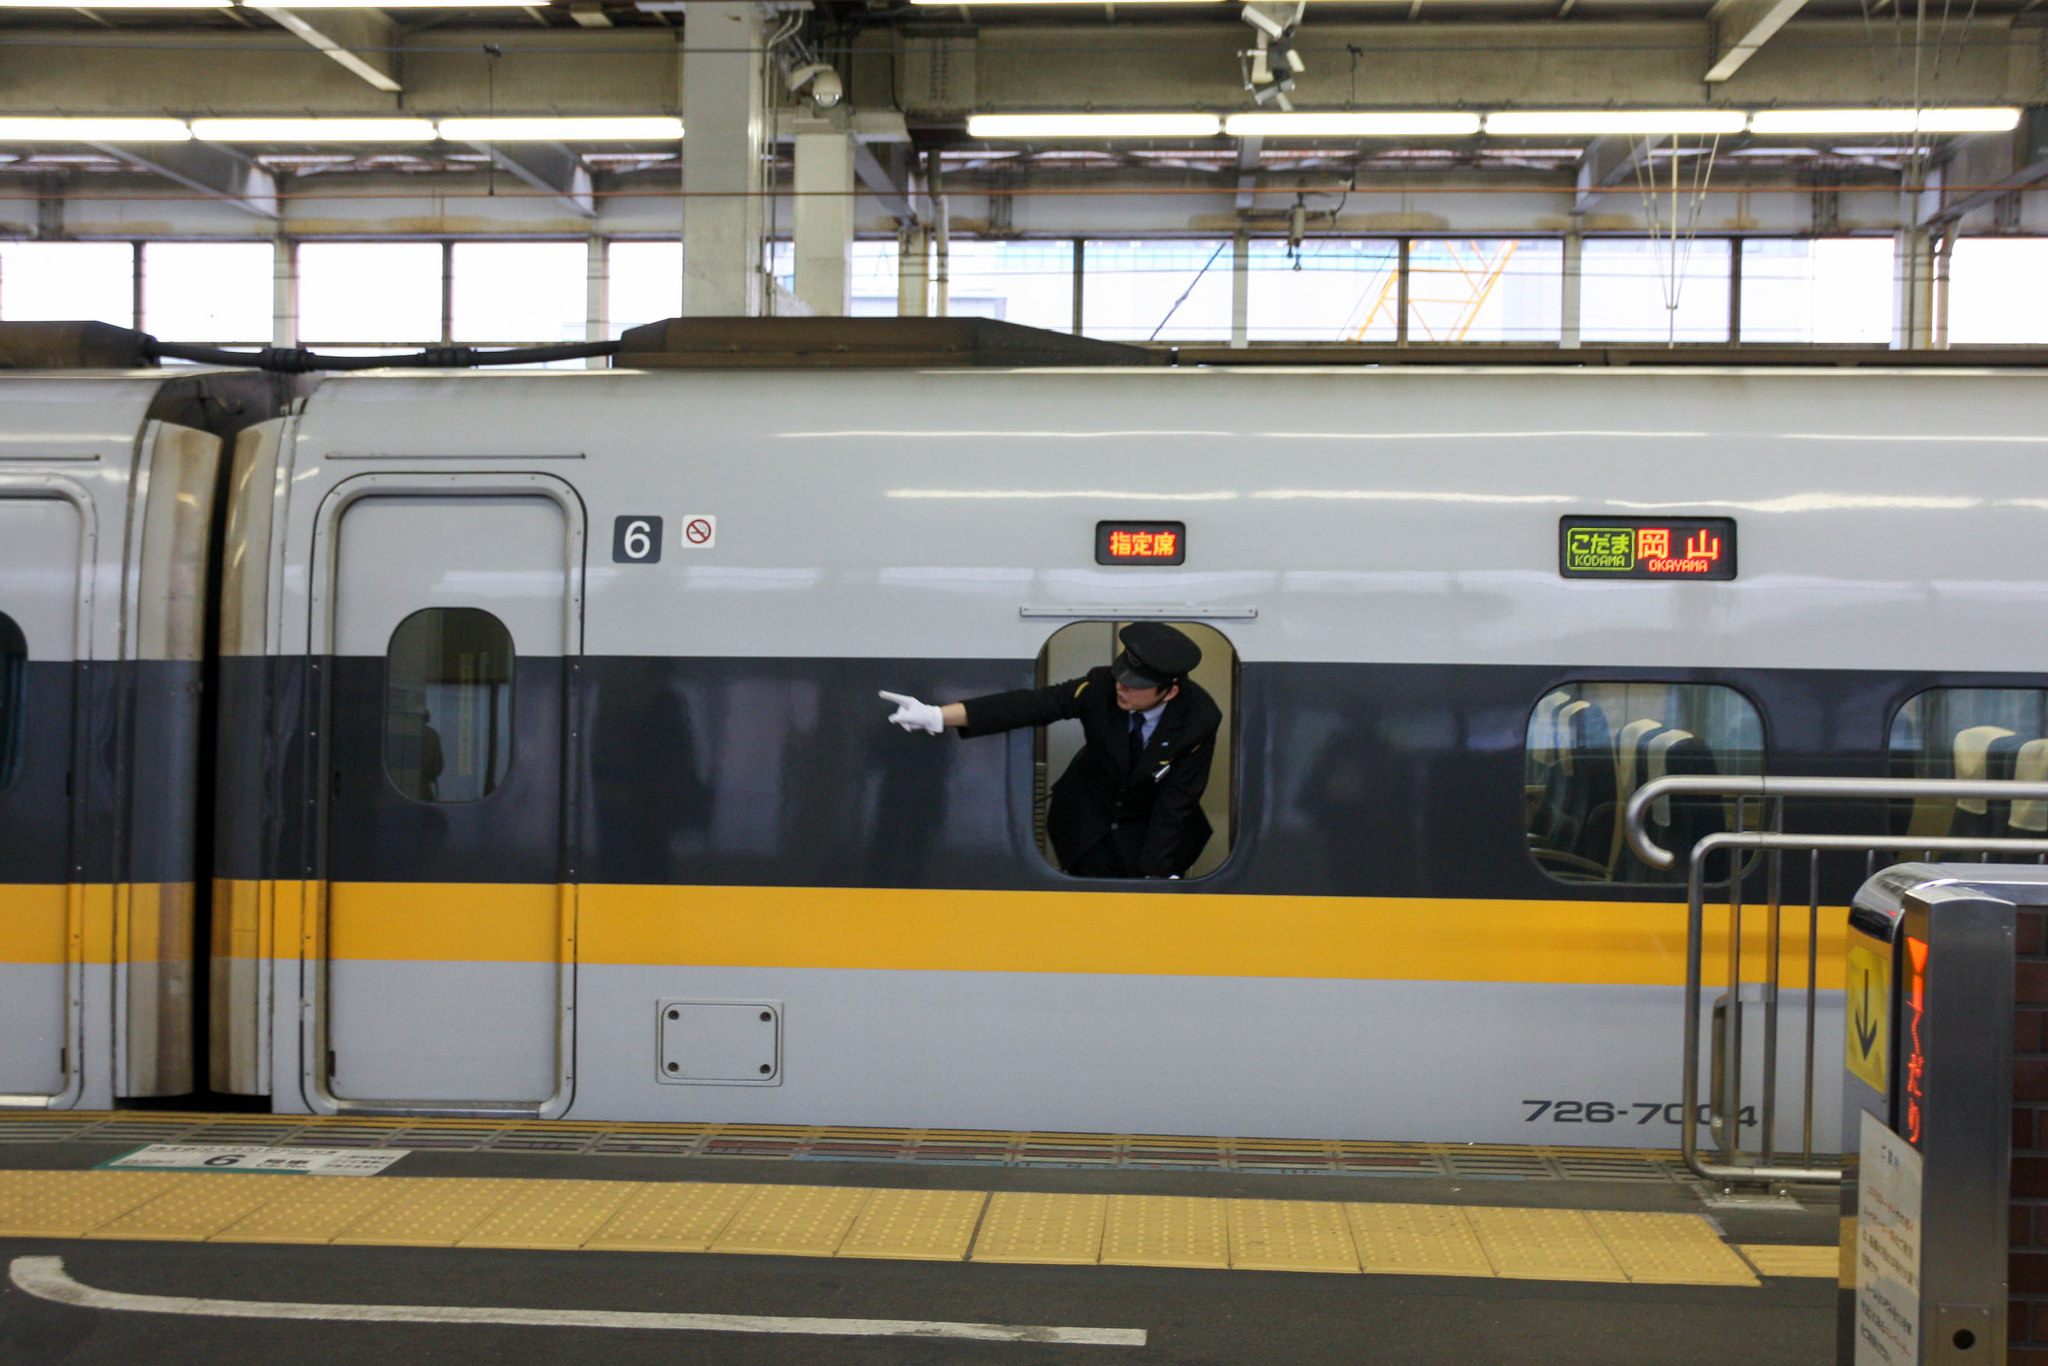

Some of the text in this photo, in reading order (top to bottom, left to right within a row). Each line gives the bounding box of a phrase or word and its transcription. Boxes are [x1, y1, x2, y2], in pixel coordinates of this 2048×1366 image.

[624, 520, 651, 559] 6
[1109, 530, 1177, 556] 指定席
[1571, 528, 1721, 560] こだま 岡山
[1574, 554, 1625, 567] KODAMA
[1648, 559, 1708, 573] OKAYAMA
[203, 1154, 247, 1166] 6
